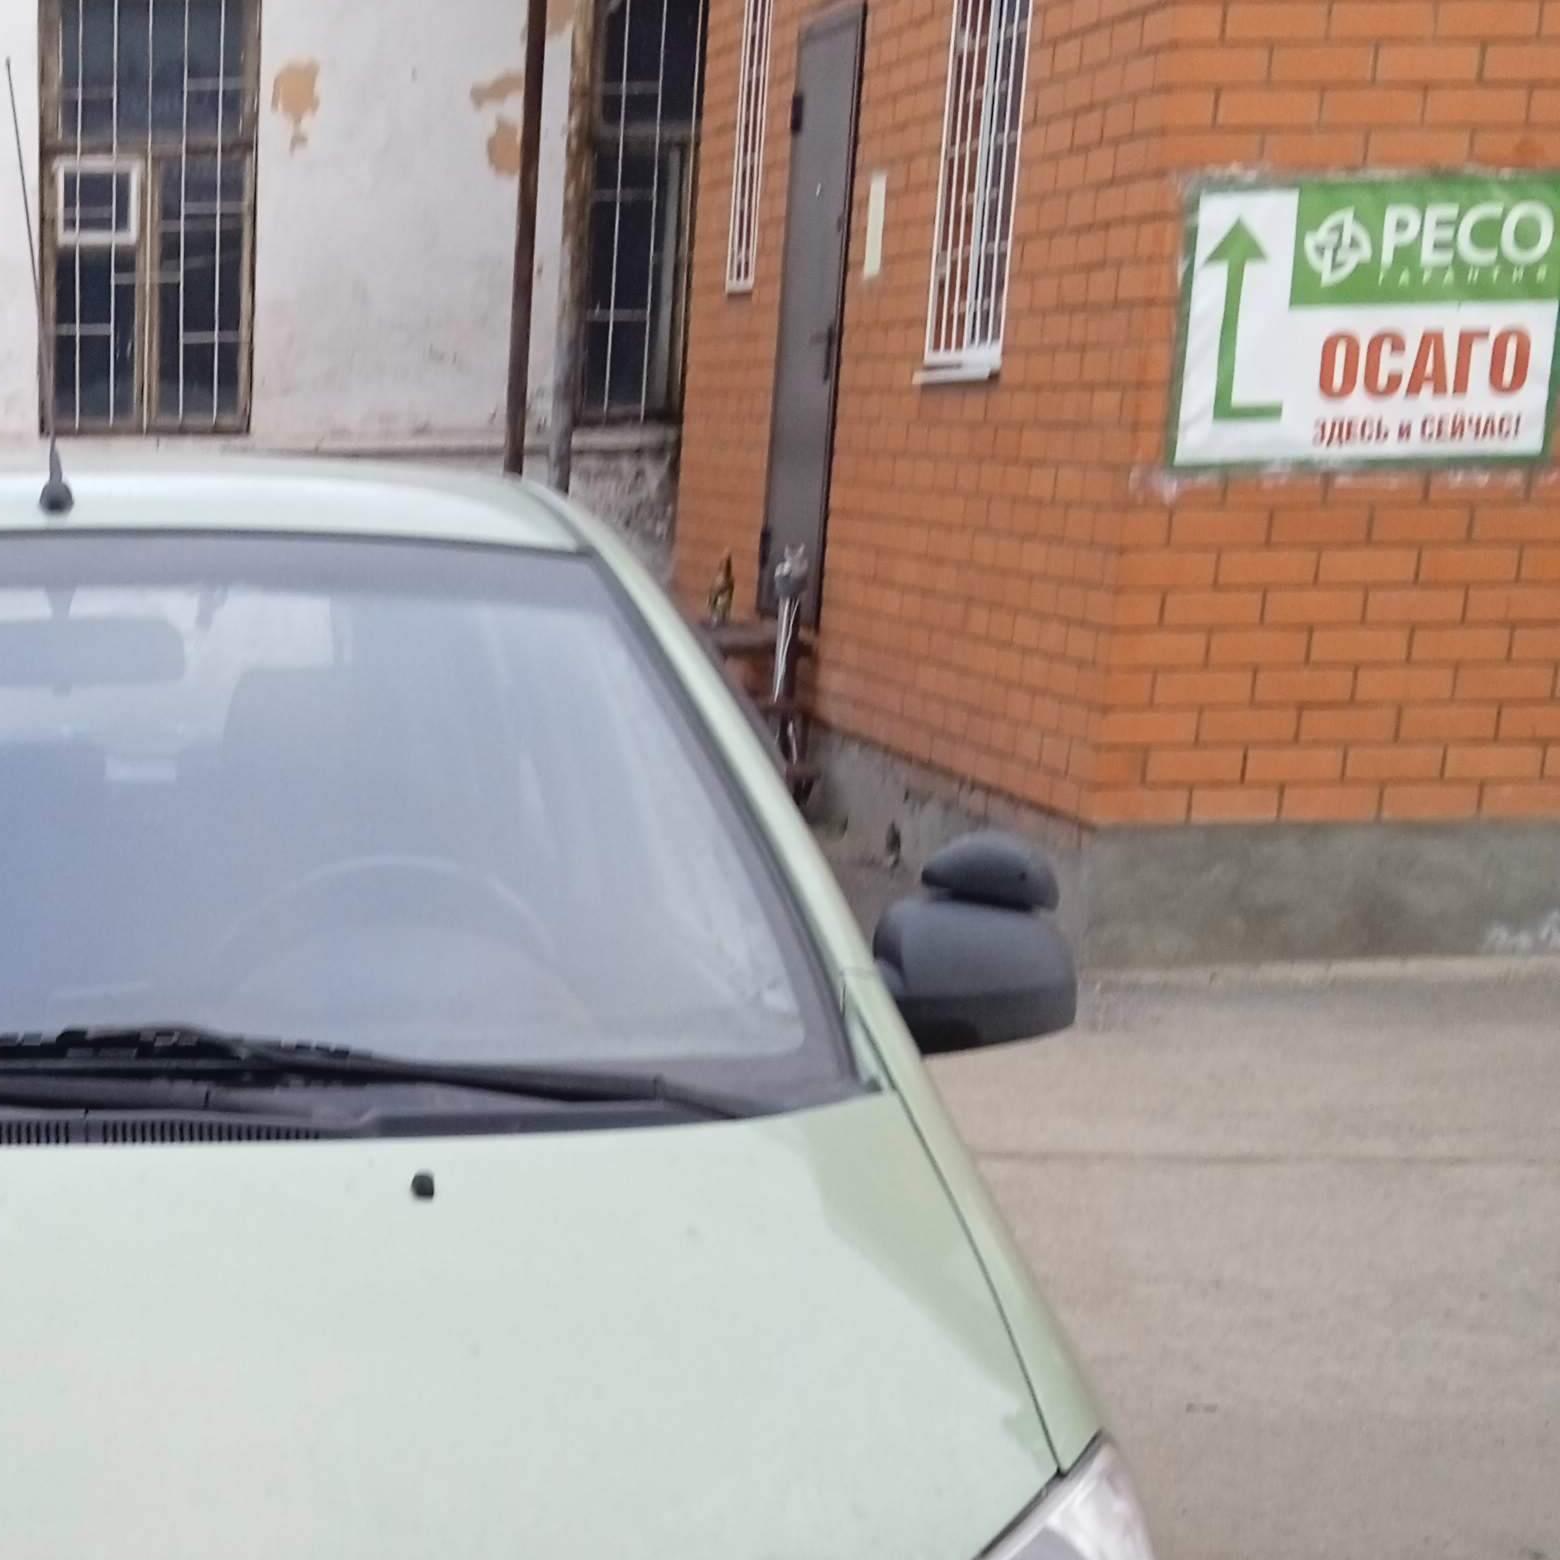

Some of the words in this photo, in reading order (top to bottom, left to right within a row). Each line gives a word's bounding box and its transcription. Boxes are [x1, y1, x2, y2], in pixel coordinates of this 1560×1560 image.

[1380, 201, 1555, 267] РЕСО
[1318, 327, 1533, 399] ОСАГО
[1312, 413, 1389, 447] ЗДЕСЬ
[1420, 408, 1523, 443] СЕЙЧАС!
